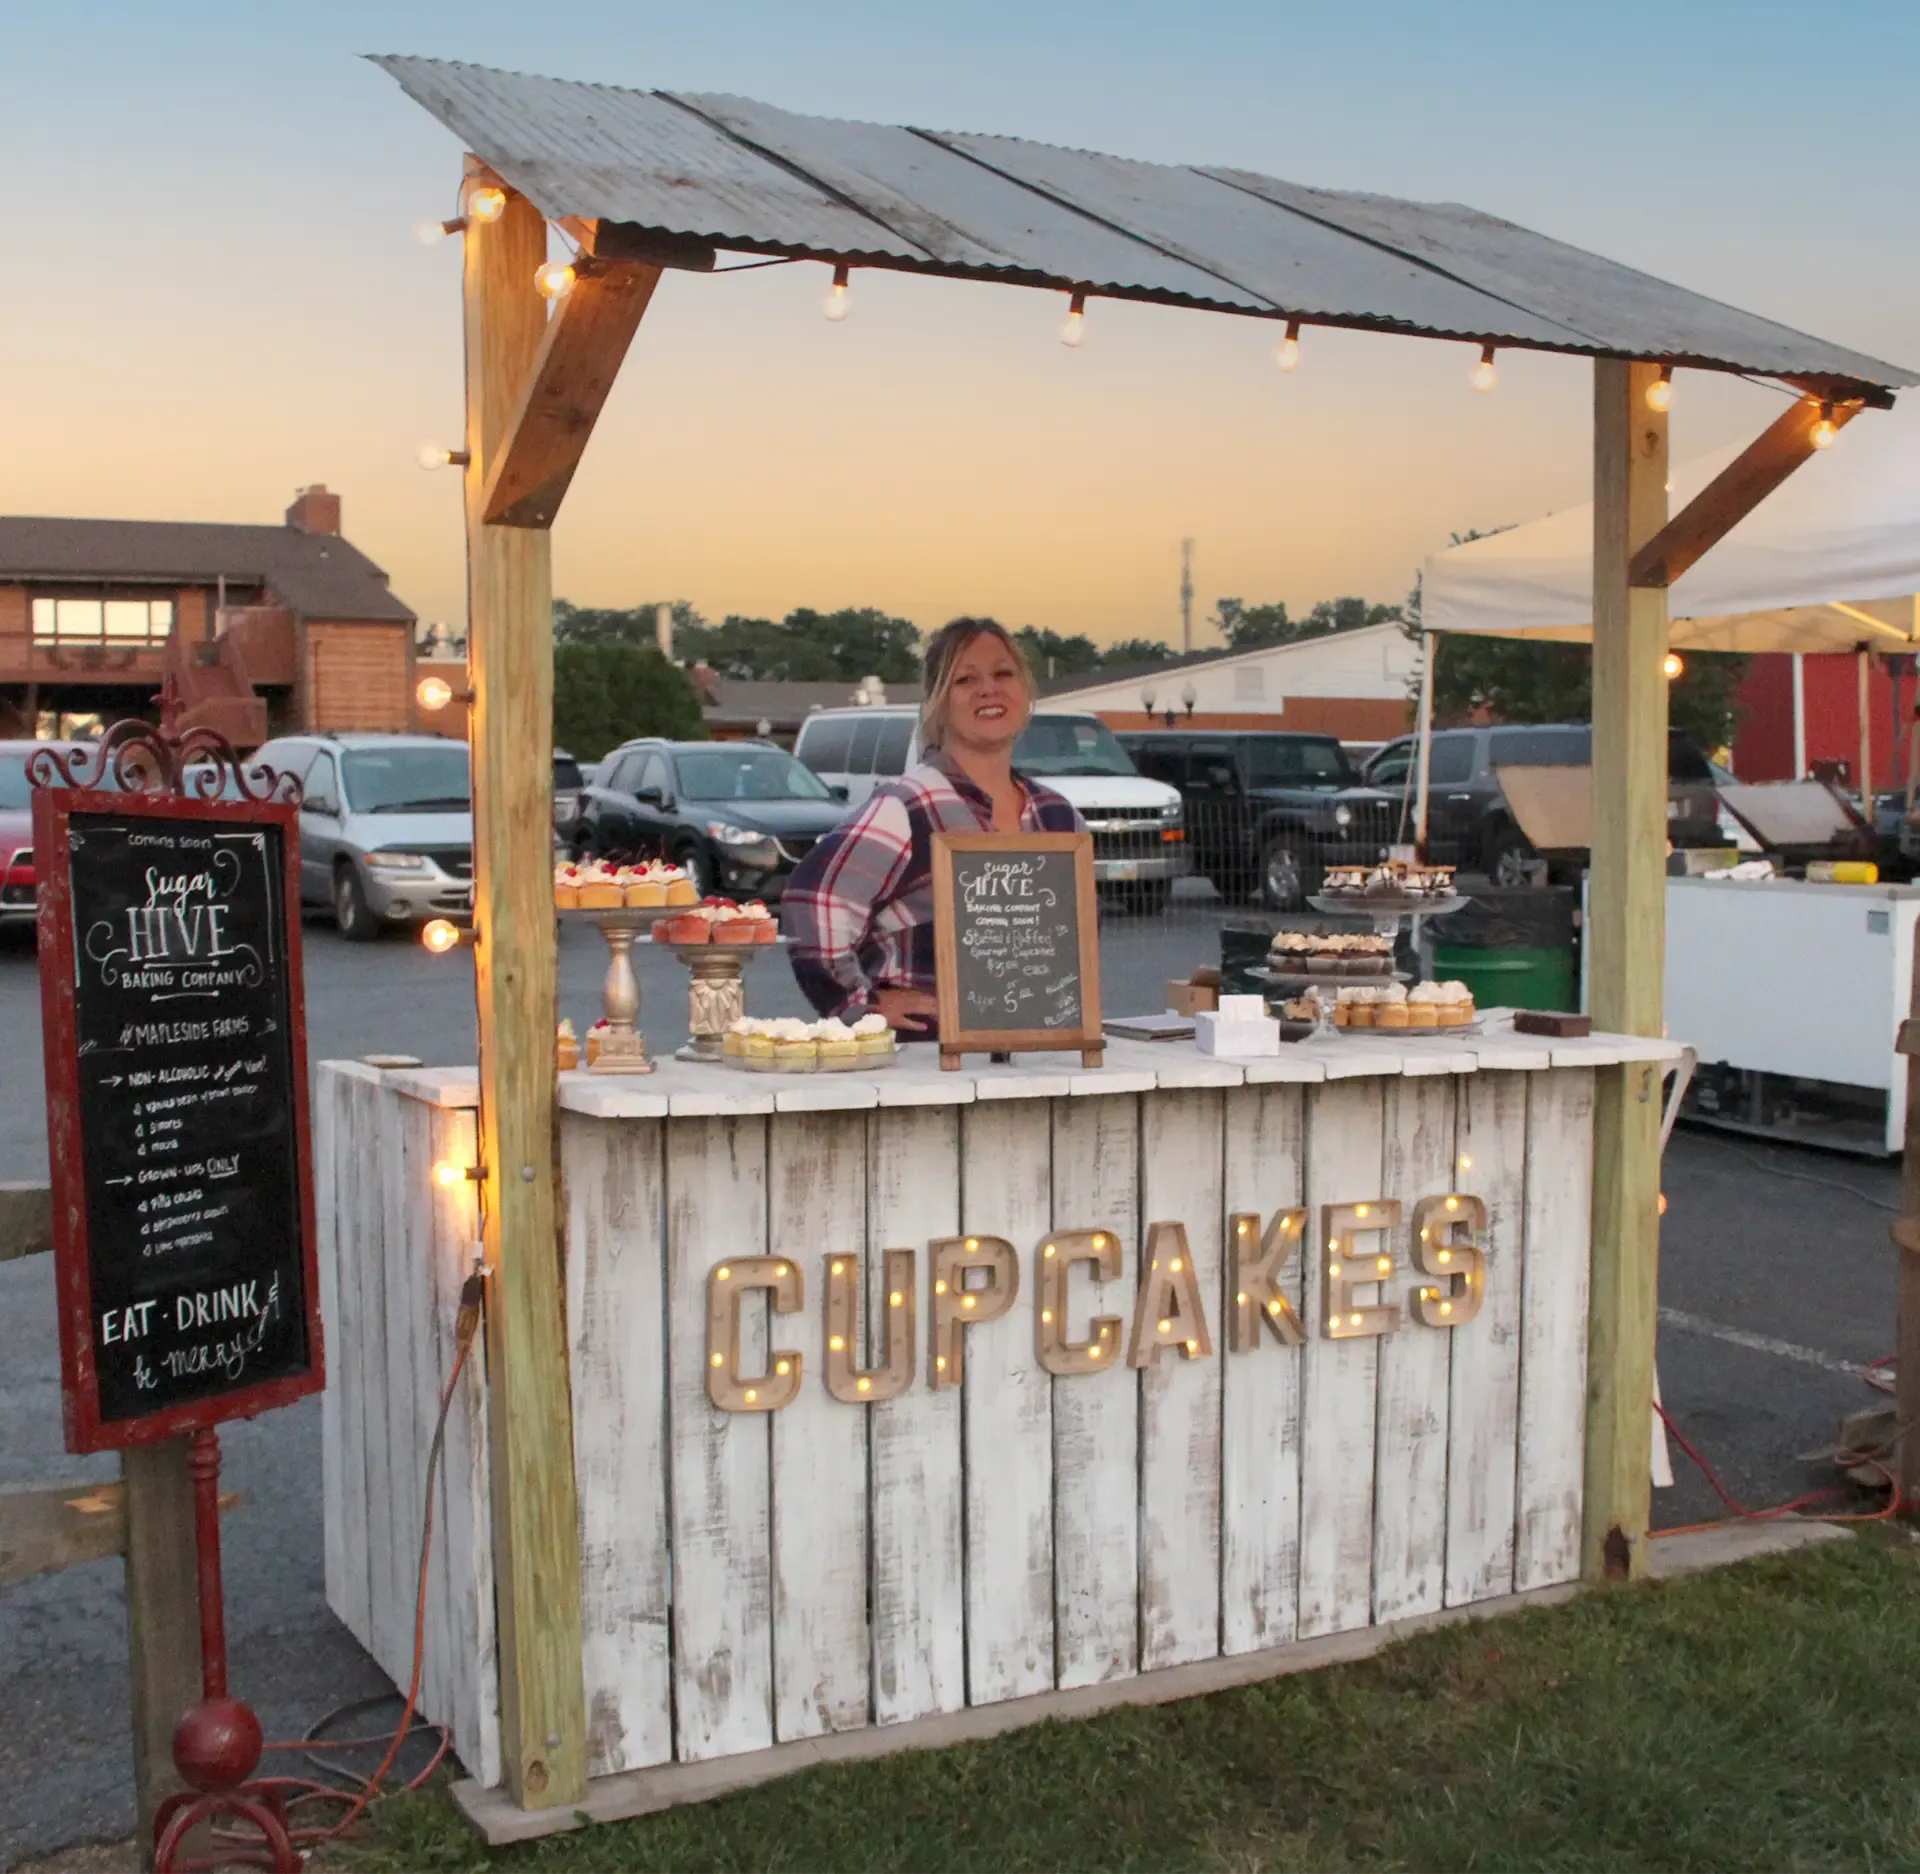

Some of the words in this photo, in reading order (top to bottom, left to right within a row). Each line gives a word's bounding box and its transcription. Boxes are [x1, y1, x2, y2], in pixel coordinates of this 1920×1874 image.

[128, 833, 174, 848] coming
[179, 836, 212, 848] soon
[975, 876, 1034, 897] HIVE
[125, 904, 234, 962] HIVE
[121, 970, 175, 988] BAKING
[181, 969, 244, 988] COMPANY
[212, 1014, 249, 1037] FARMS
[206, 1153, 240, 1175] ONLY
[102, 1299, 157, 1346] EAT
[175, 1278, 260, 1332] DRINK
[703, 1193, 1487, 1413] CUPCAKES
[132, 1355, 160, 1390] be
